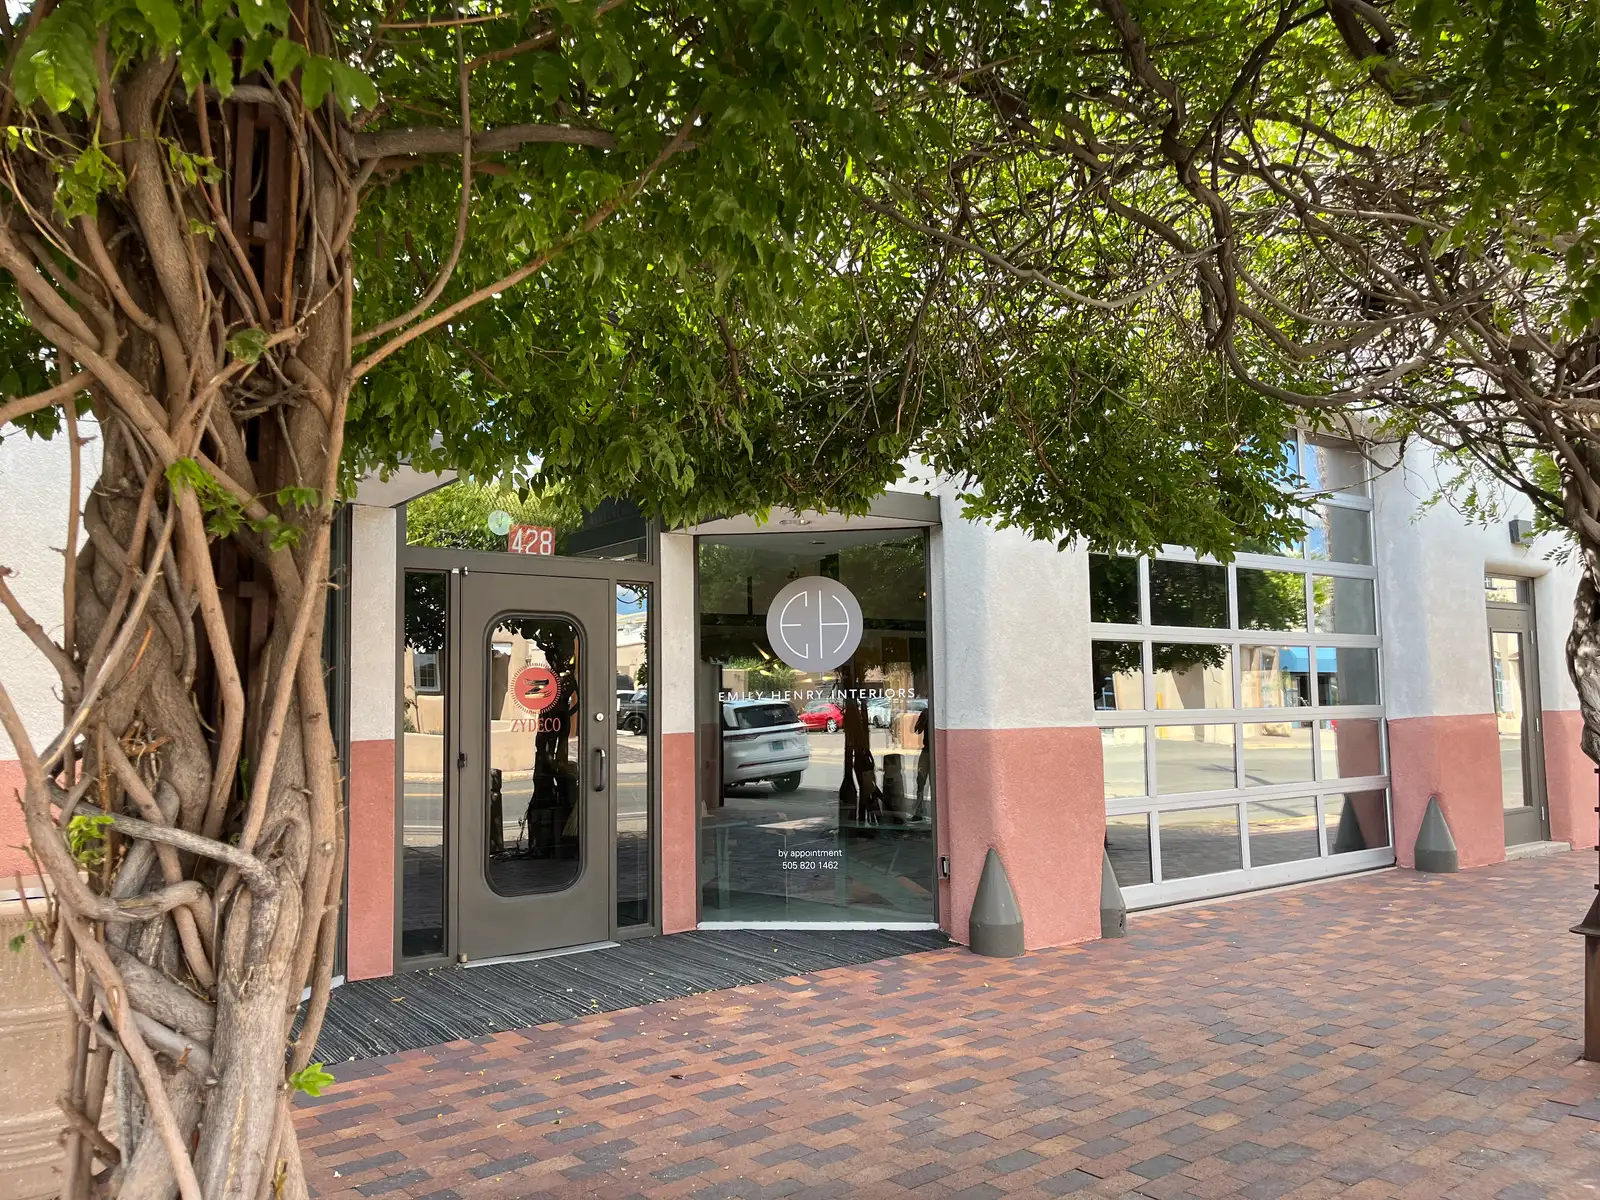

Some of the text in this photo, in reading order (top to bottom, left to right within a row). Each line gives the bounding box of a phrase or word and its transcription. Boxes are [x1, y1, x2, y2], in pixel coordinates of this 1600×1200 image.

[511, 527, 553, 556] 428
[718, 687, 916, 702] EMILY HENRY INTERIORS
[511, 717, 561, 733] ZYDECO
[778, 849, 843, 858] by appointment
[782, 861, 839, 870] 505 820 1462
